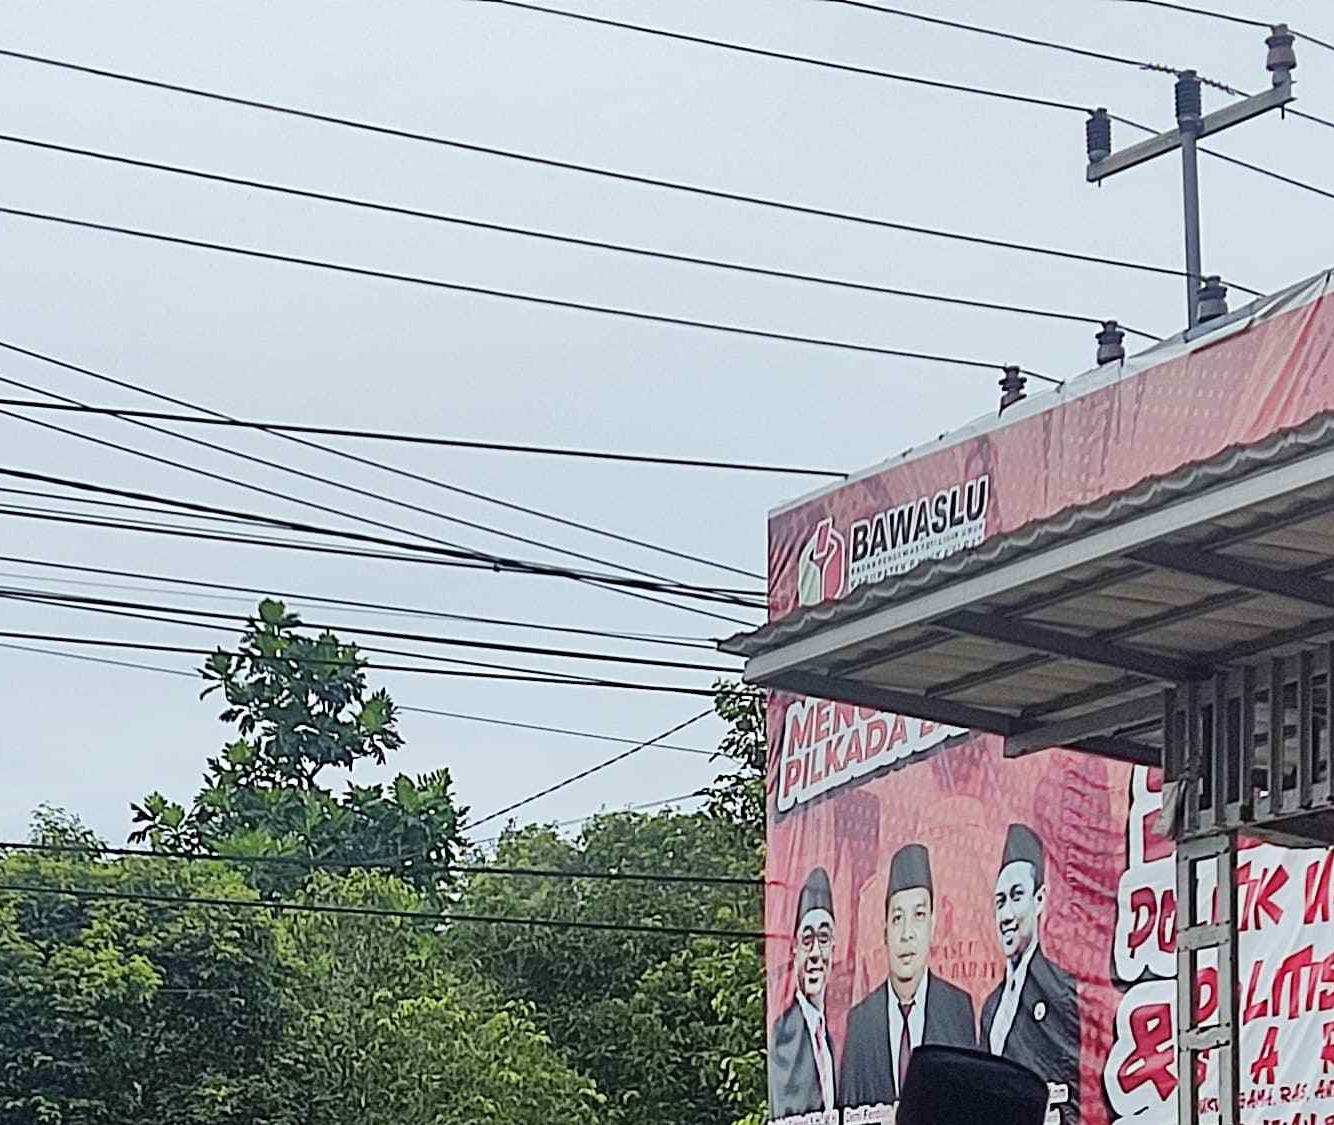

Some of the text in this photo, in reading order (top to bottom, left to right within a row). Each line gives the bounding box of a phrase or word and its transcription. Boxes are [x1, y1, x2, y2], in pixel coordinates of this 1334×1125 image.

[851, 480, 986, 563] BAWASLU
[784, 714, 908, 798] PILKADA
[789, 700, 874, 757] MEN
